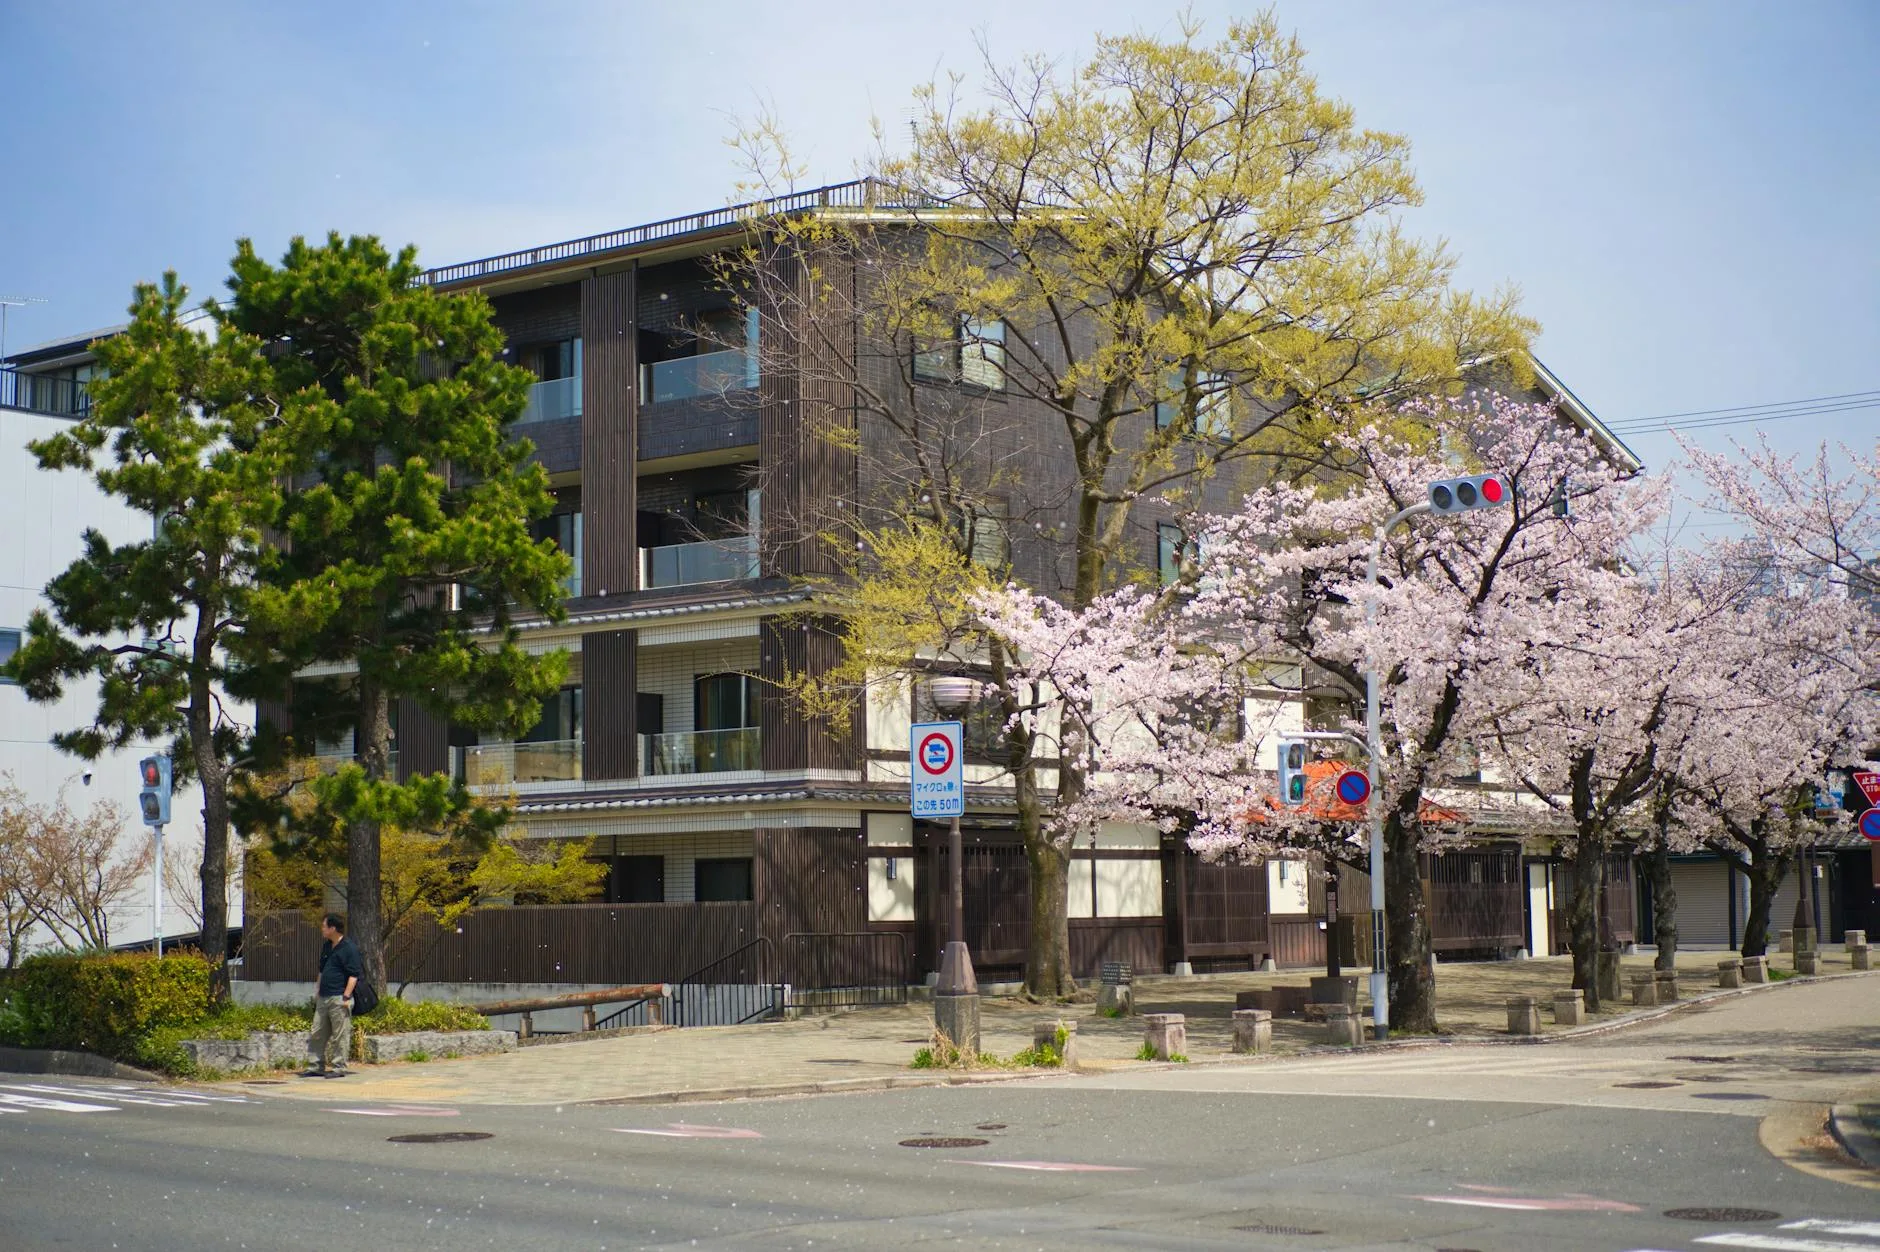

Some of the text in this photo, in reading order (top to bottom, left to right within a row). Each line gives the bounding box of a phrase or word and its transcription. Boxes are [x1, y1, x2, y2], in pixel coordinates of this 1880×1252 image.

[1862, 776, 1880, 784] 止ま
[916, 800, 937, 811] この先
